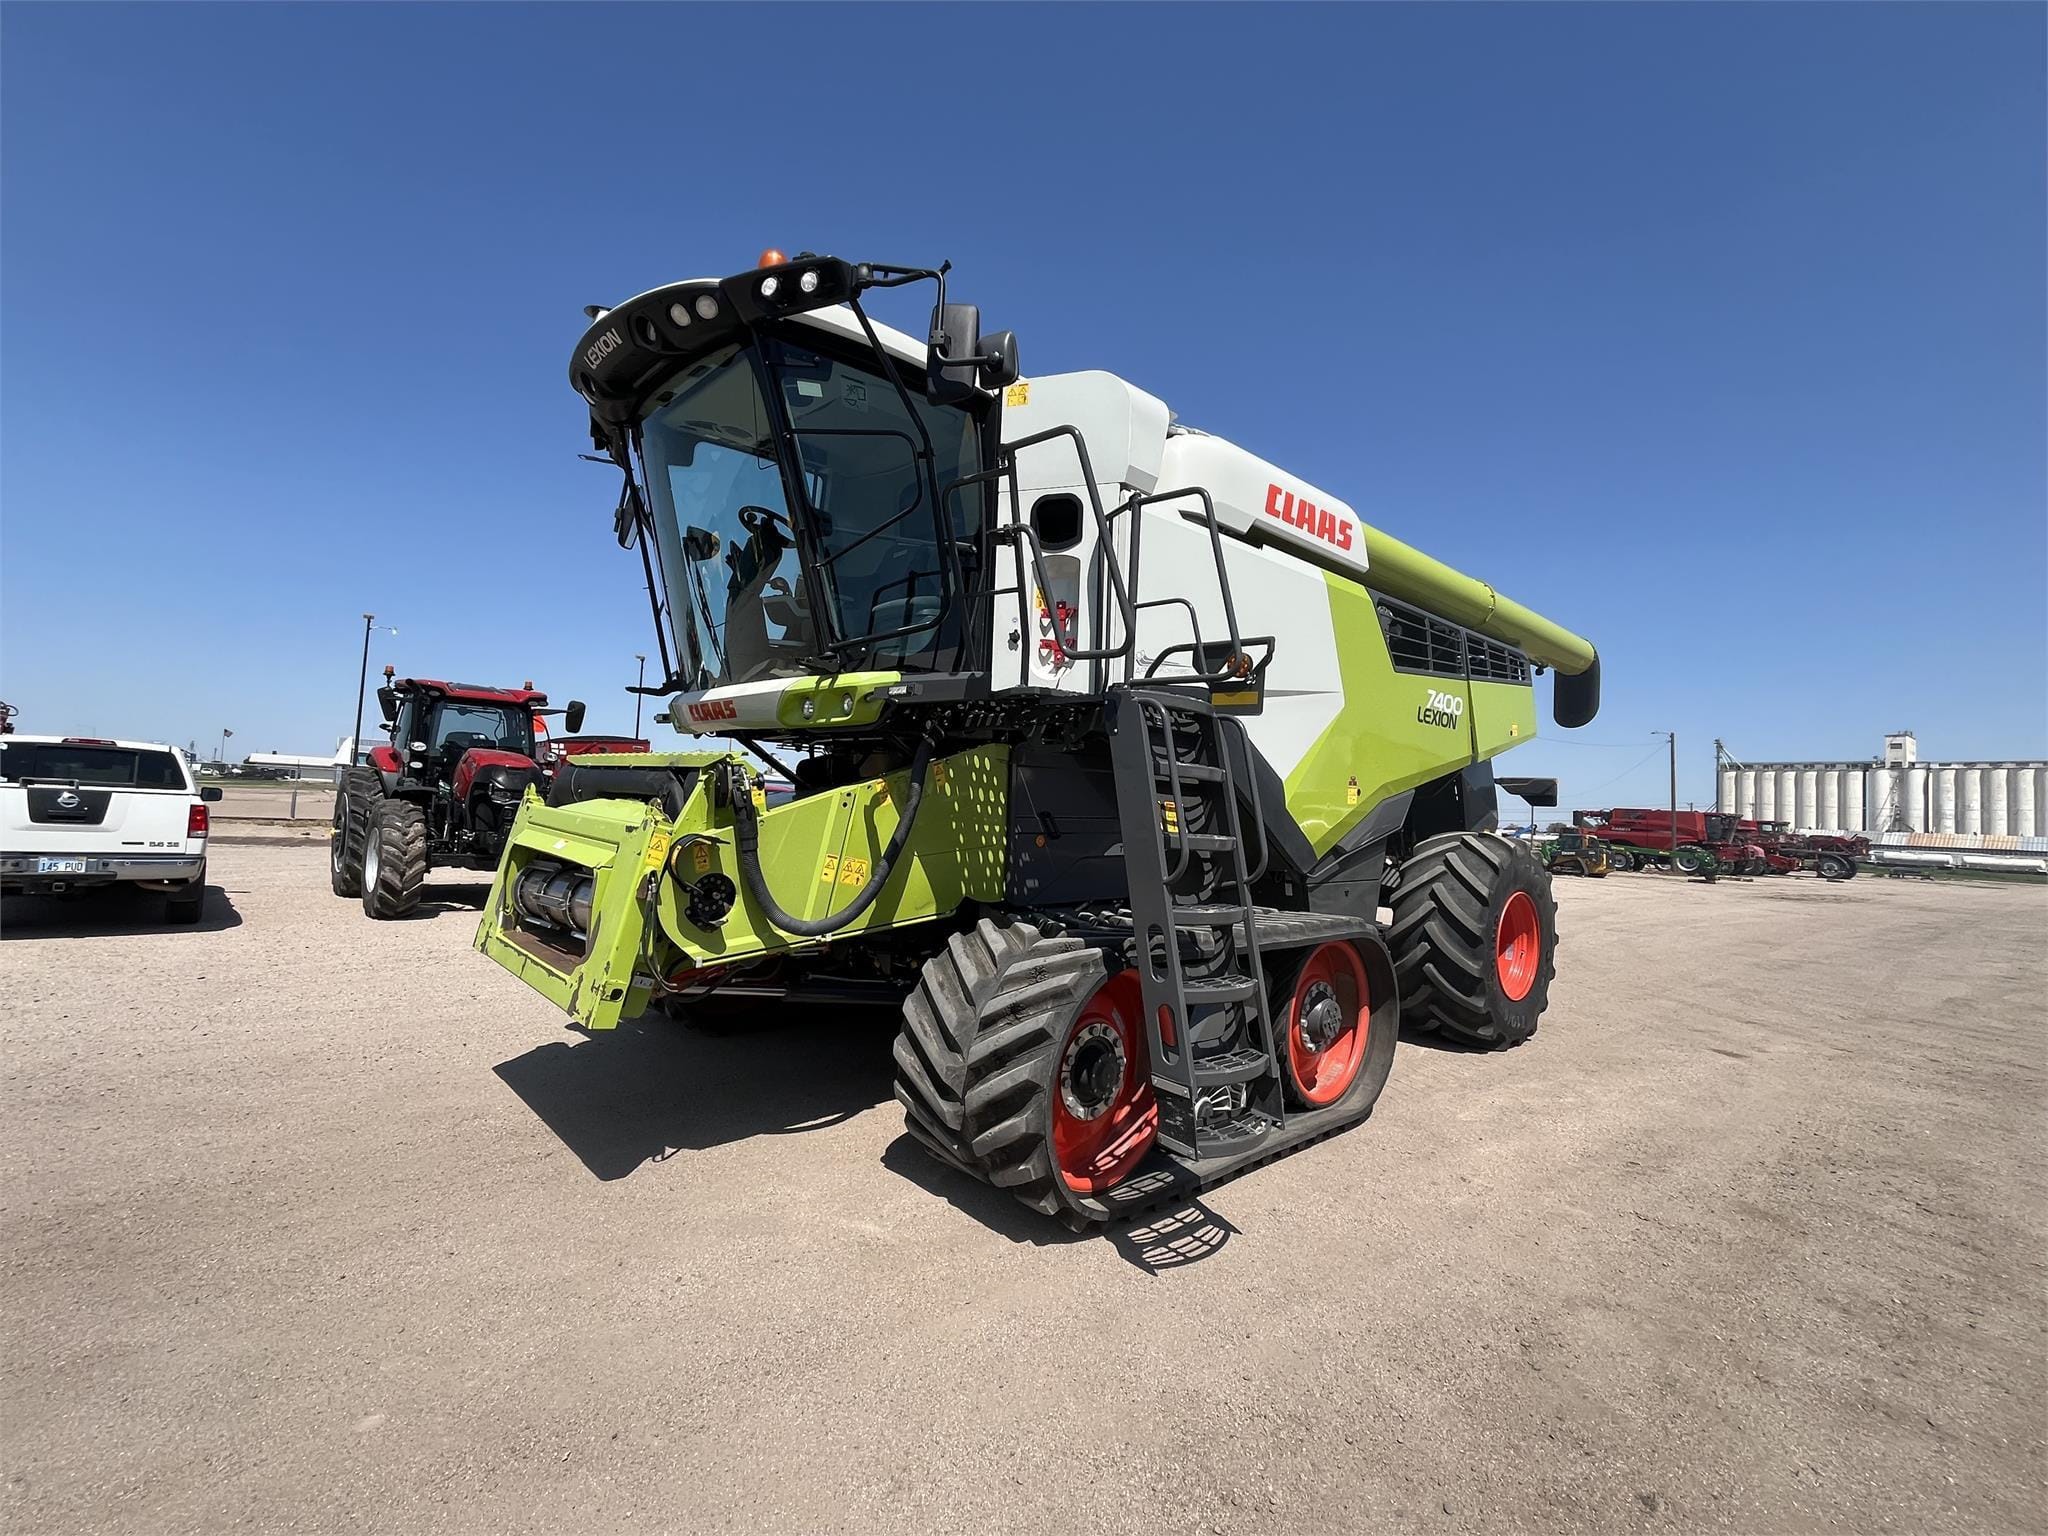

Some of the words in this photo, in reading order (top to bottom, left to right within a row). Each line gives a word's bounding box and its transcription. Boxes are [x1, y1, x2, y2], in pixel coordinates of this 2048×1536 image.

[583, 327, 623, 370] LEXION
[1265, 483, 1353, 551] CLAAS
[688, 700, 737, 721] CLAAS
[1426, 688, 1463, 716] 7400
[1417, 705, 1458, 730] LEXION
[40, 862, 59, 872] 145
